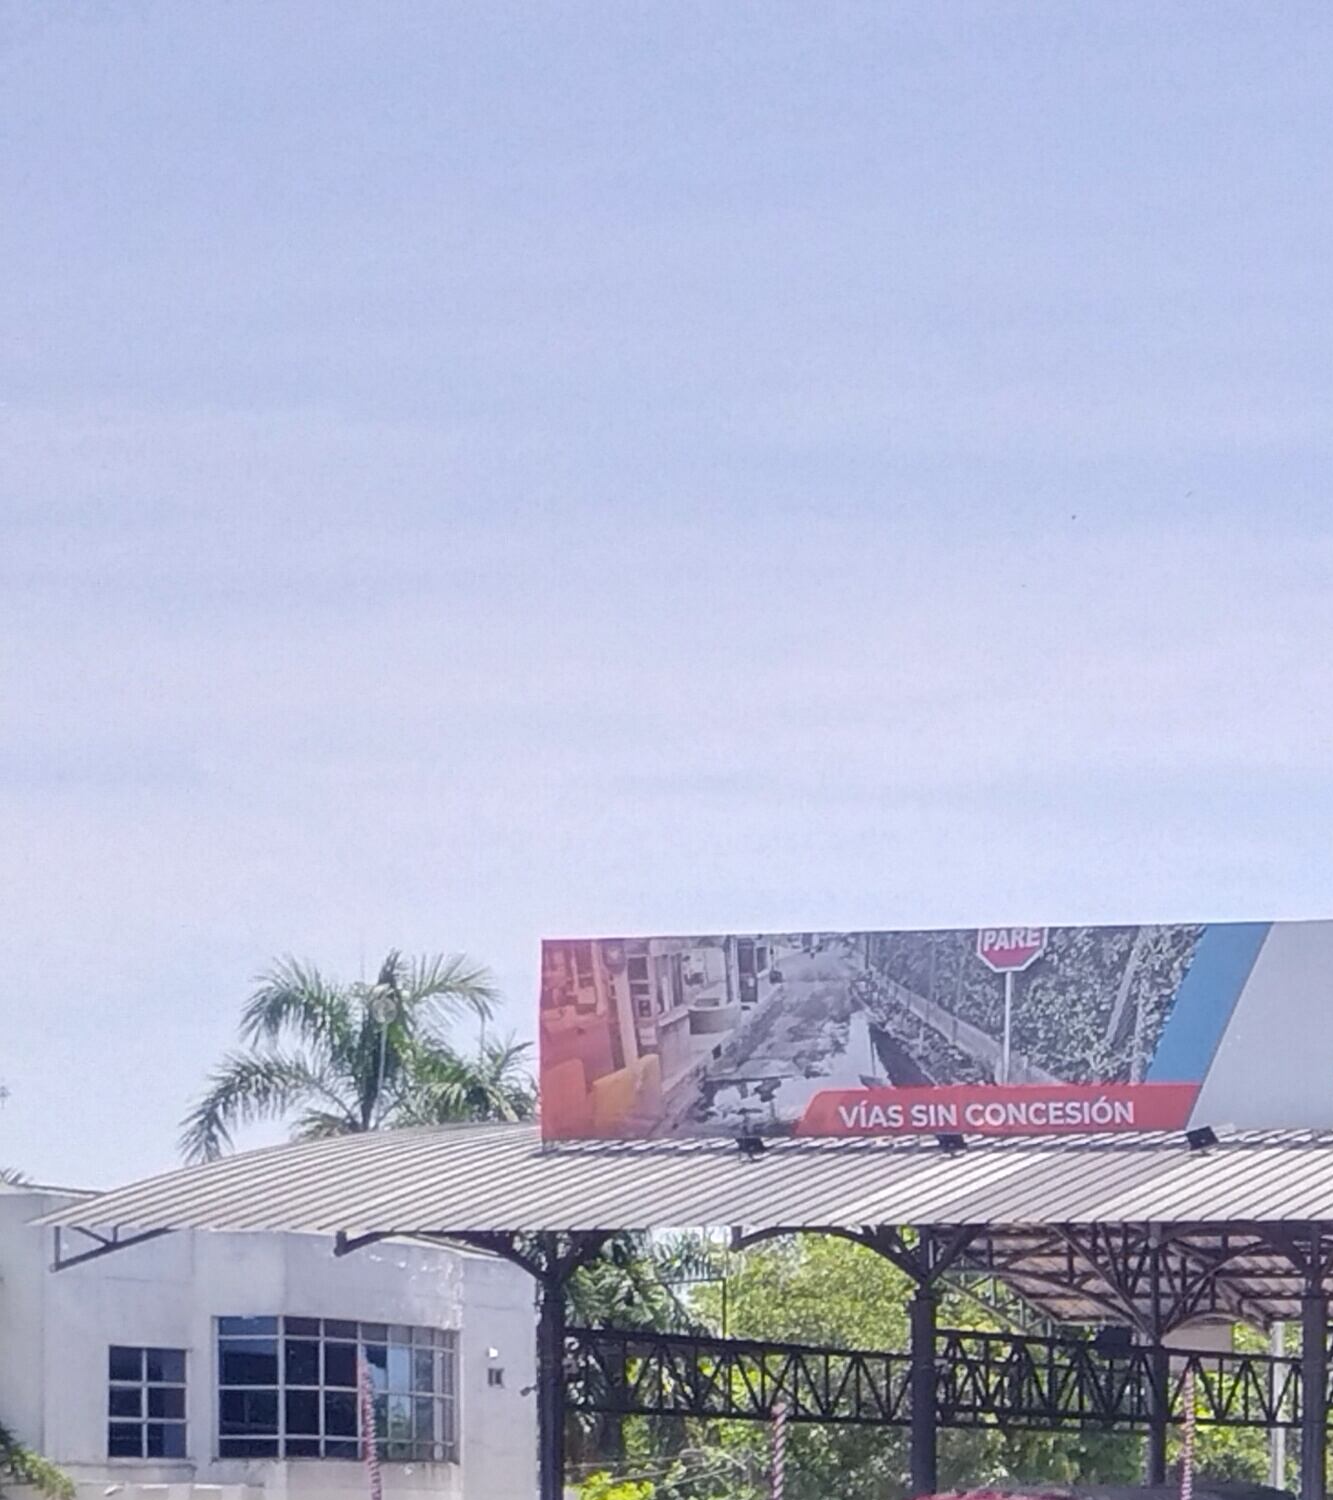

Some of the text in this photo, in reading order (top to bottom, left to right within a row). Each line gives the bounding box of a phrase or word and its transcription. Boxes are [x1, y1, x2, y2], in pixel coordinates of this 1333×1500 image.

[838, 1096, 1135, 1128] VÍAS SIN CONCESIÓN
